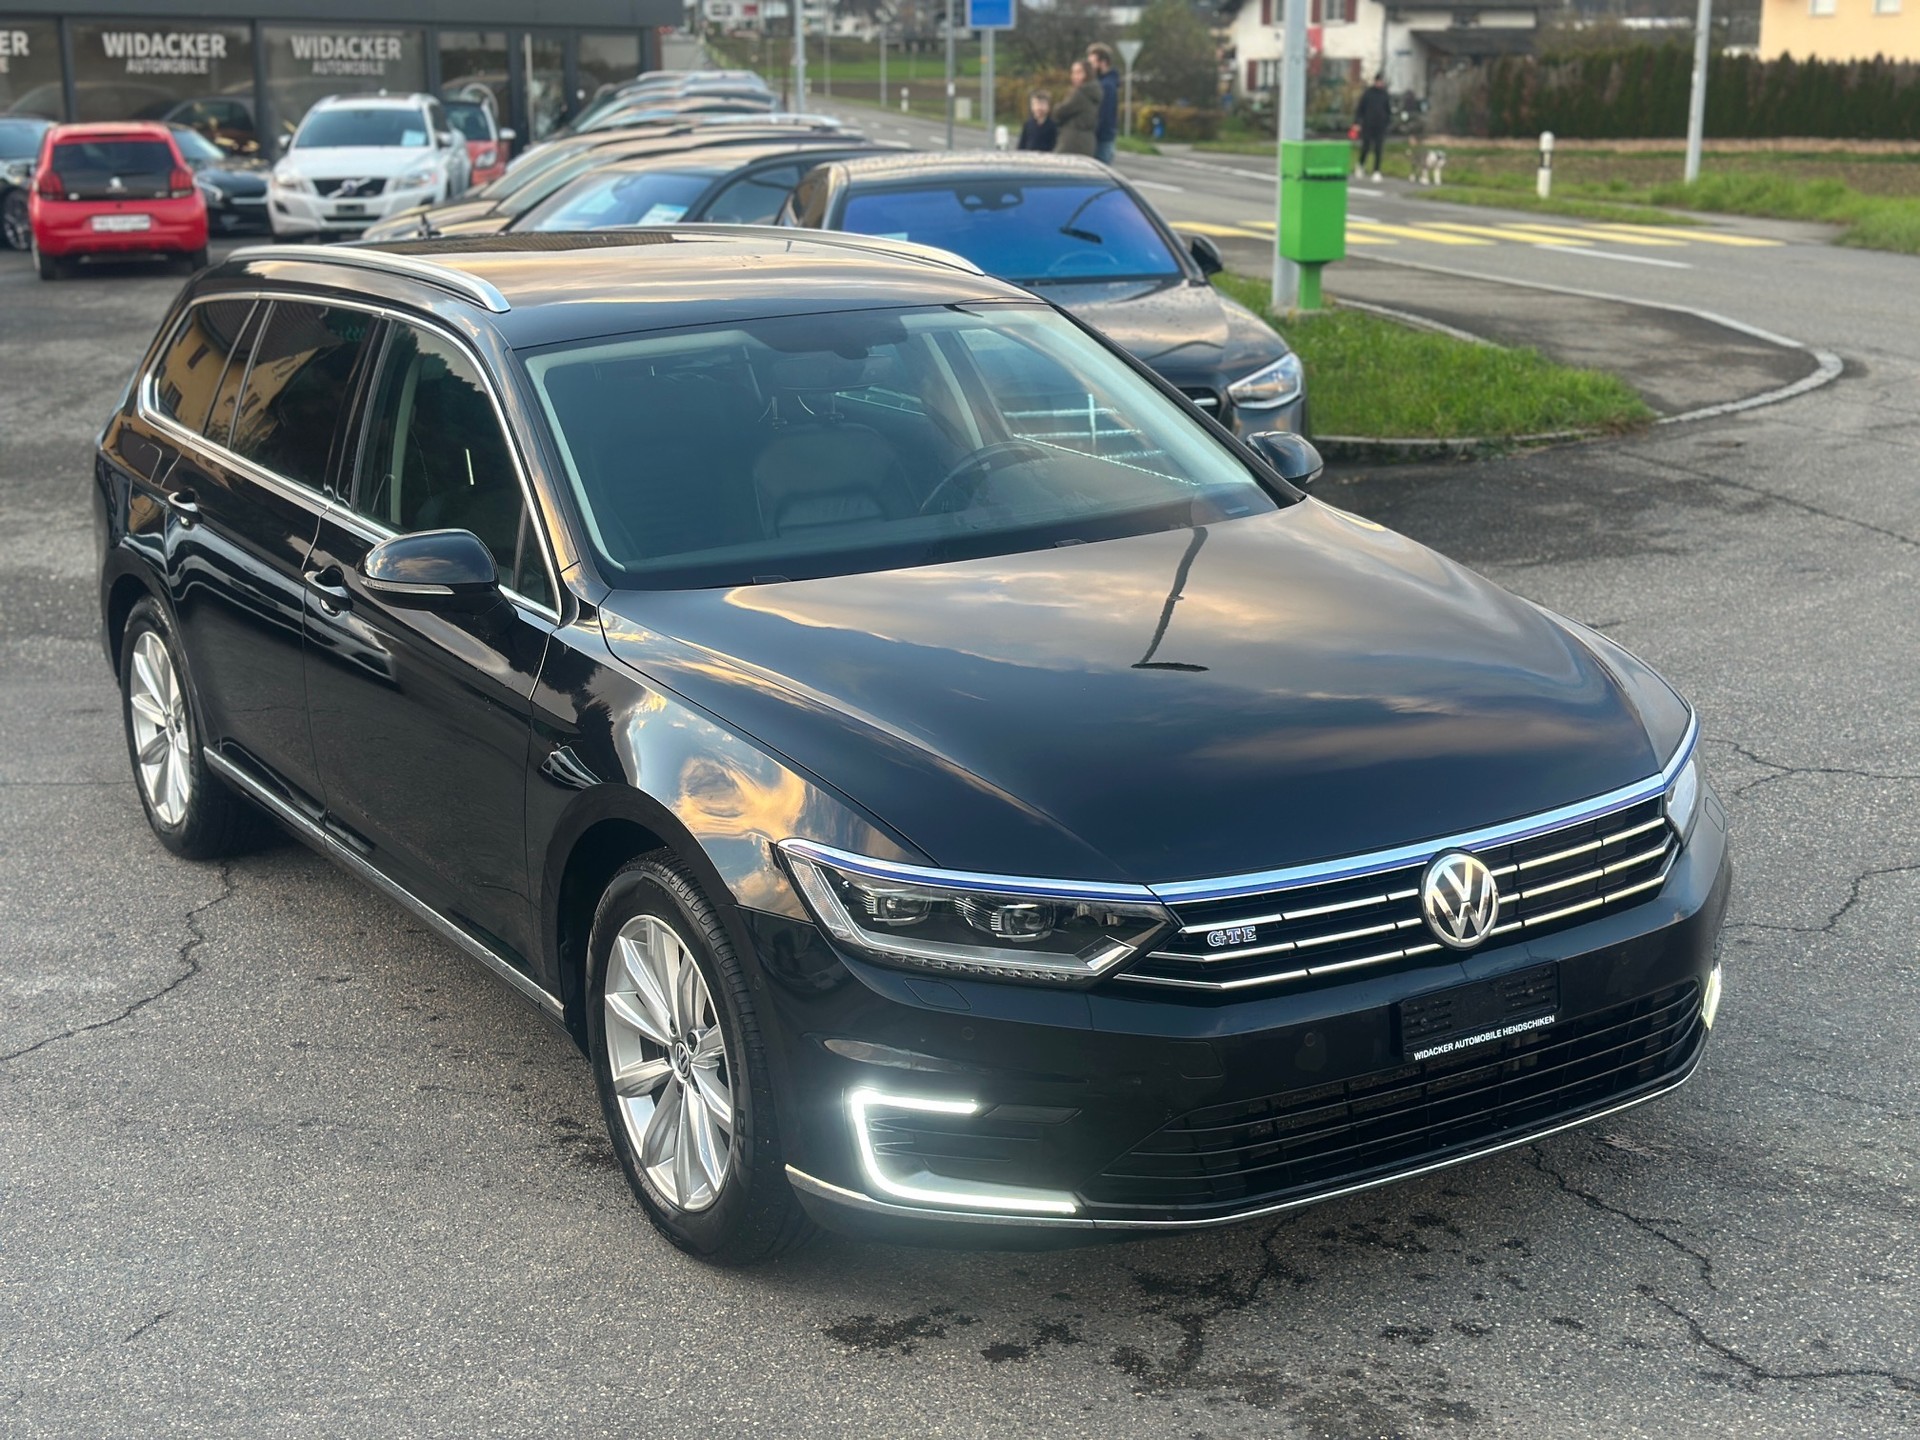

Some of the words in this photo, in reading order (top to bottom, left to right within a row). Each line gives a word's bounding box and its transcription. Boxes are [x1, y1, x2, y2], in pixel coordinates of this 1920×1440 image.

[102, 32, 227, 58] WIDACKER
[291, 35, 402, 60] WIDACKER
[125, 58, 209, 74] AUTOMOBILE
[312, 60, 385, 75] AUTOMOBILE
[1206, 925, 1257, 947] GTE
[1413, 1042, 1454, 1061] WIDACKER
[1454, 1029, 1502, 1049] AUTOMOBILE
[1503, 1014, 1555, 1035] HENDSCHIKEN
